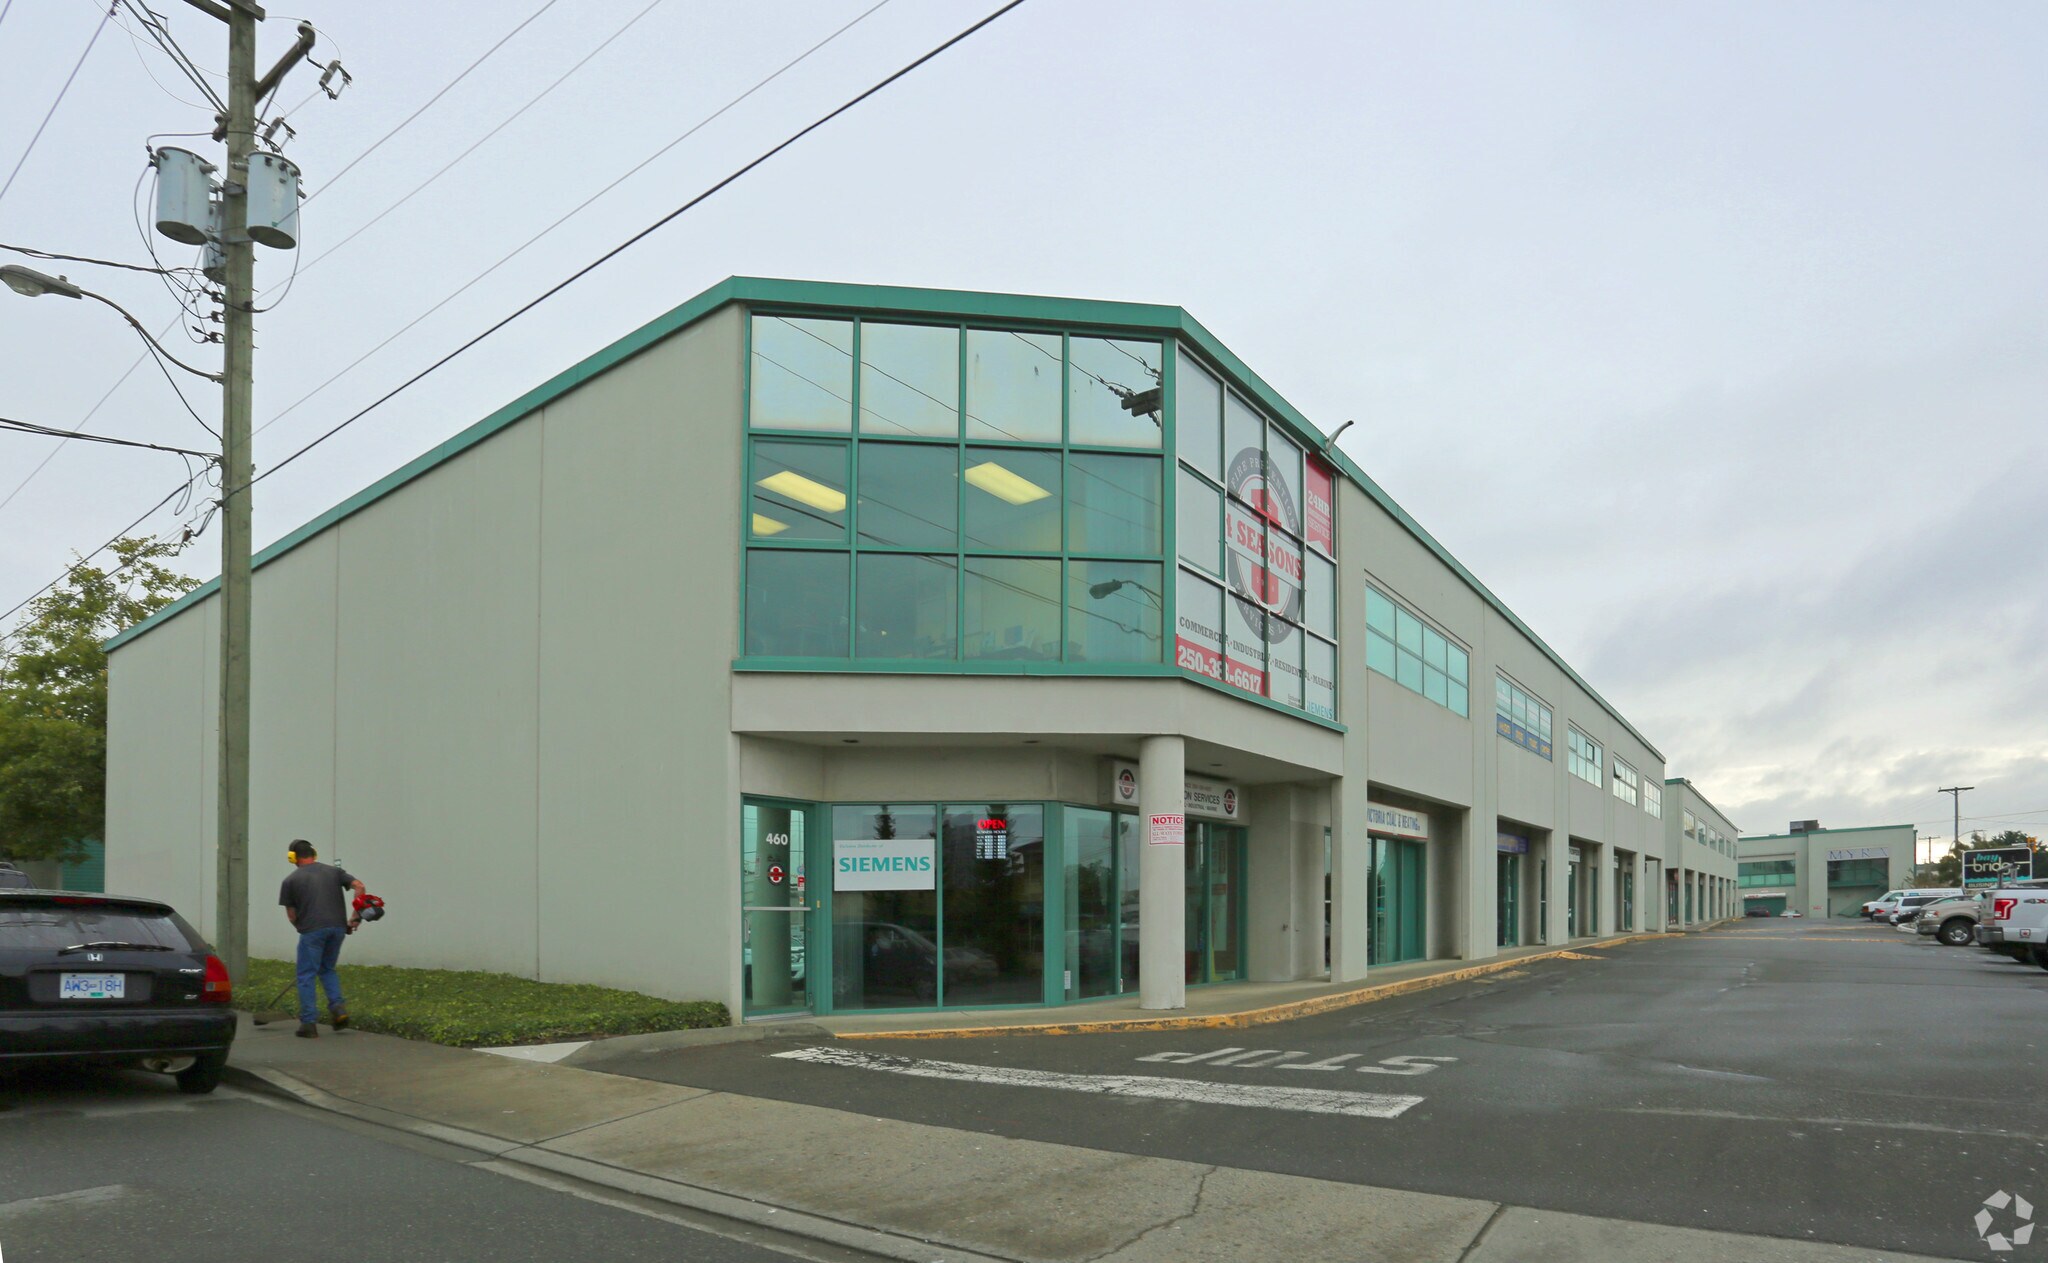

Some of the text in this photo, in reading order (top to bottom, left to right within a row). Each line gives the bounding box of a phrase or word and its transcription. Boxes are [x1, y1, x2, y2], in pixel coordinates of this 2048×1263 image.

[1308, 490, 1330, 518] 24HR
[1194, 792, 1220, 805] SERVICES
[977, 818, 1006, 830] OPEN
[1152, 816, 1183, 825] NOTICE
[766, 833, 788, 845] 460
[1976, 853, 1999, 862] bay
[839, 856, 931, 872] SIEMENS
[1135, 1048, 1459, 1076] STOP
